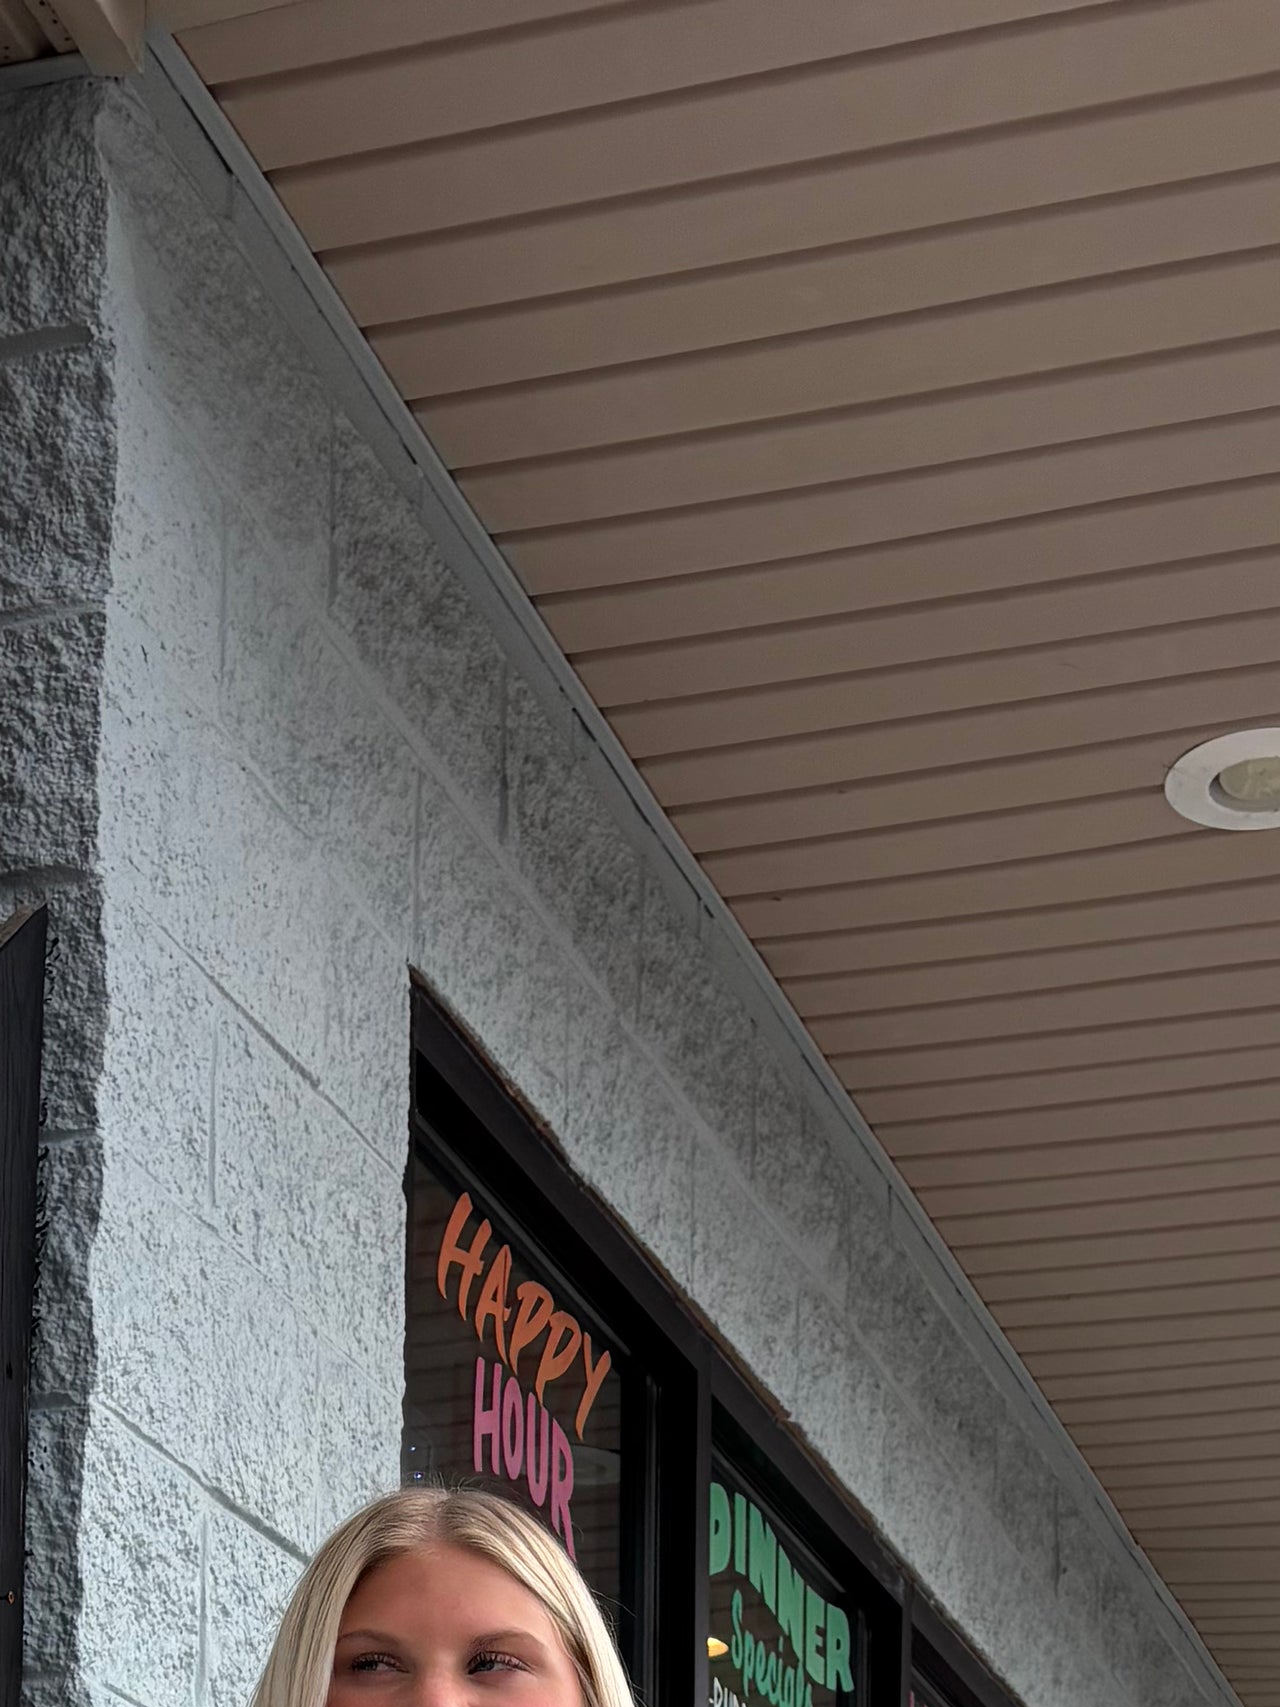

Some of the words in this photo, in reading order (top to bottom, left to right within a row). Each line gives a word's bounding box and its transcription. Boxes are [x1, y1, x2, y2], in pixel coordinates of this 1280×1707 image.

[437, 1191, 612, 1441] HAPPY
[473, 1356, 577, 1562] HOUR
[708, 1481, 855, 1693] DINNER
